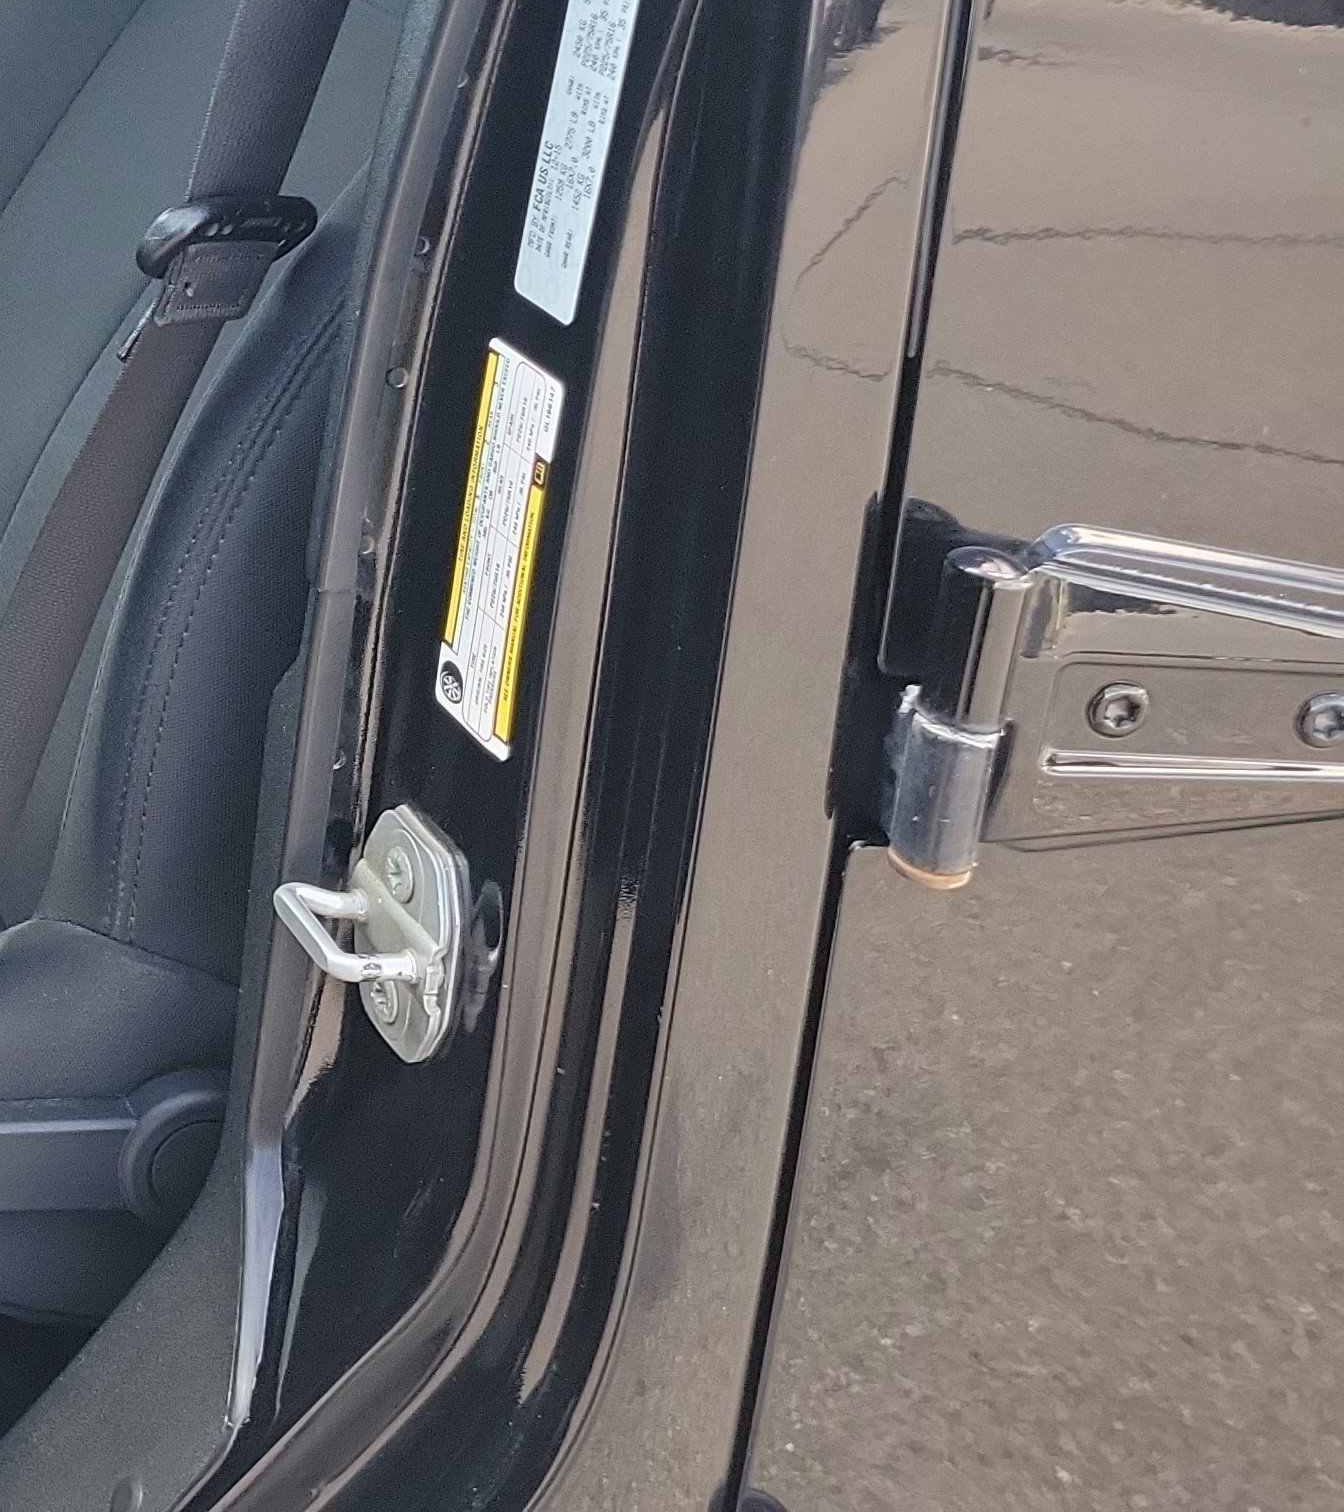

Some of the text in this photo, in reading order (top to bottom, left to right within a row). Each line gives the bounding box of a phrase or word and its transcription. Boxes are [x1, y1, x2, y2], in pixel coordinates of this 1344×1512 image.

[542, 139, 553, 165] LLC
[538, 165, 548, 185] US
[533, 186, 544, 212] FCA
